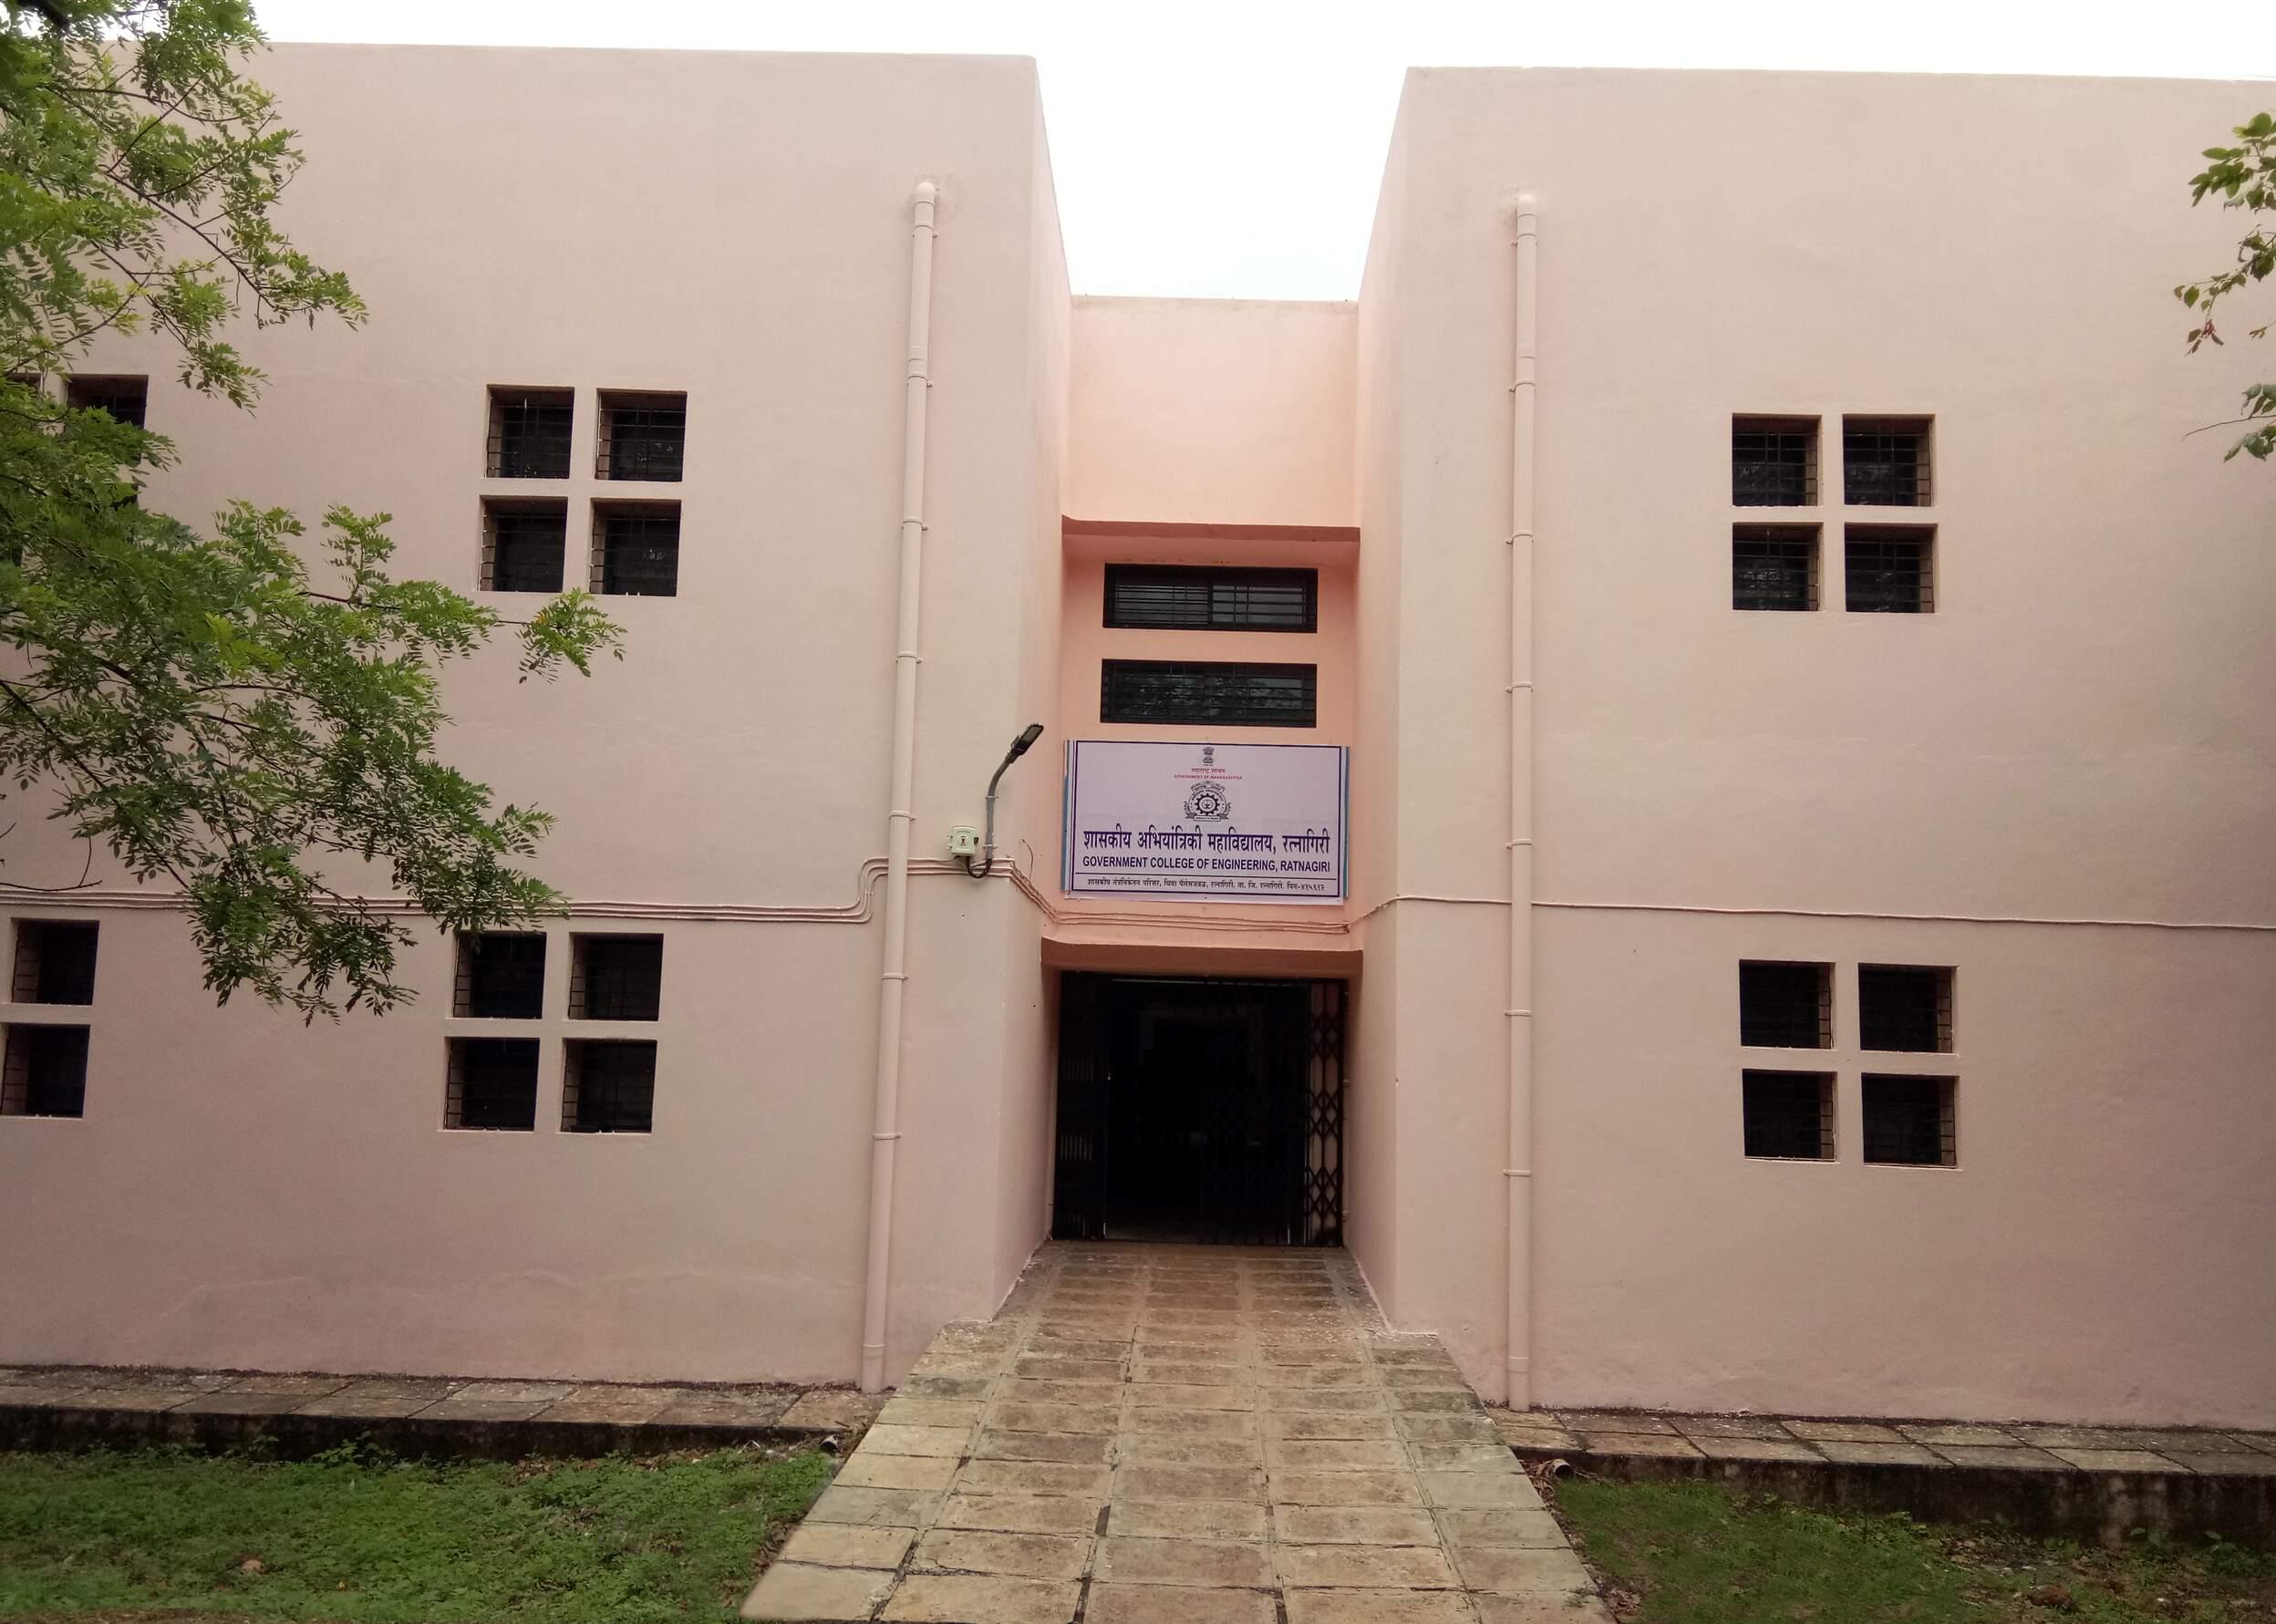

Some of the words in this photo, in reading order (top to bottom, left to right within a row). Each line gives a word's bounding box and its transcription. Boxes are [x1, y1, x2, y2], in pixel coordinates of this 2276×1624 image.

[1083, 822, 1132, 849] शासकीय
[1137, 824, 1203, 850] अभियांत्रिकी
[1207, 826, 1277, 854] महाविद्यालय,
[1282, 828, 1330, 853] रत्नागिरी
[1082, 856, 1148, 868] GOVERNMENT
[1150, 857, 1195, 869] COLLEGE
[1196, 858, 1209, 869] OF
[1212, 859, 1278, 873] ENGINEERING,
[1280, 861, 1330, 872] RATNAGIRI
